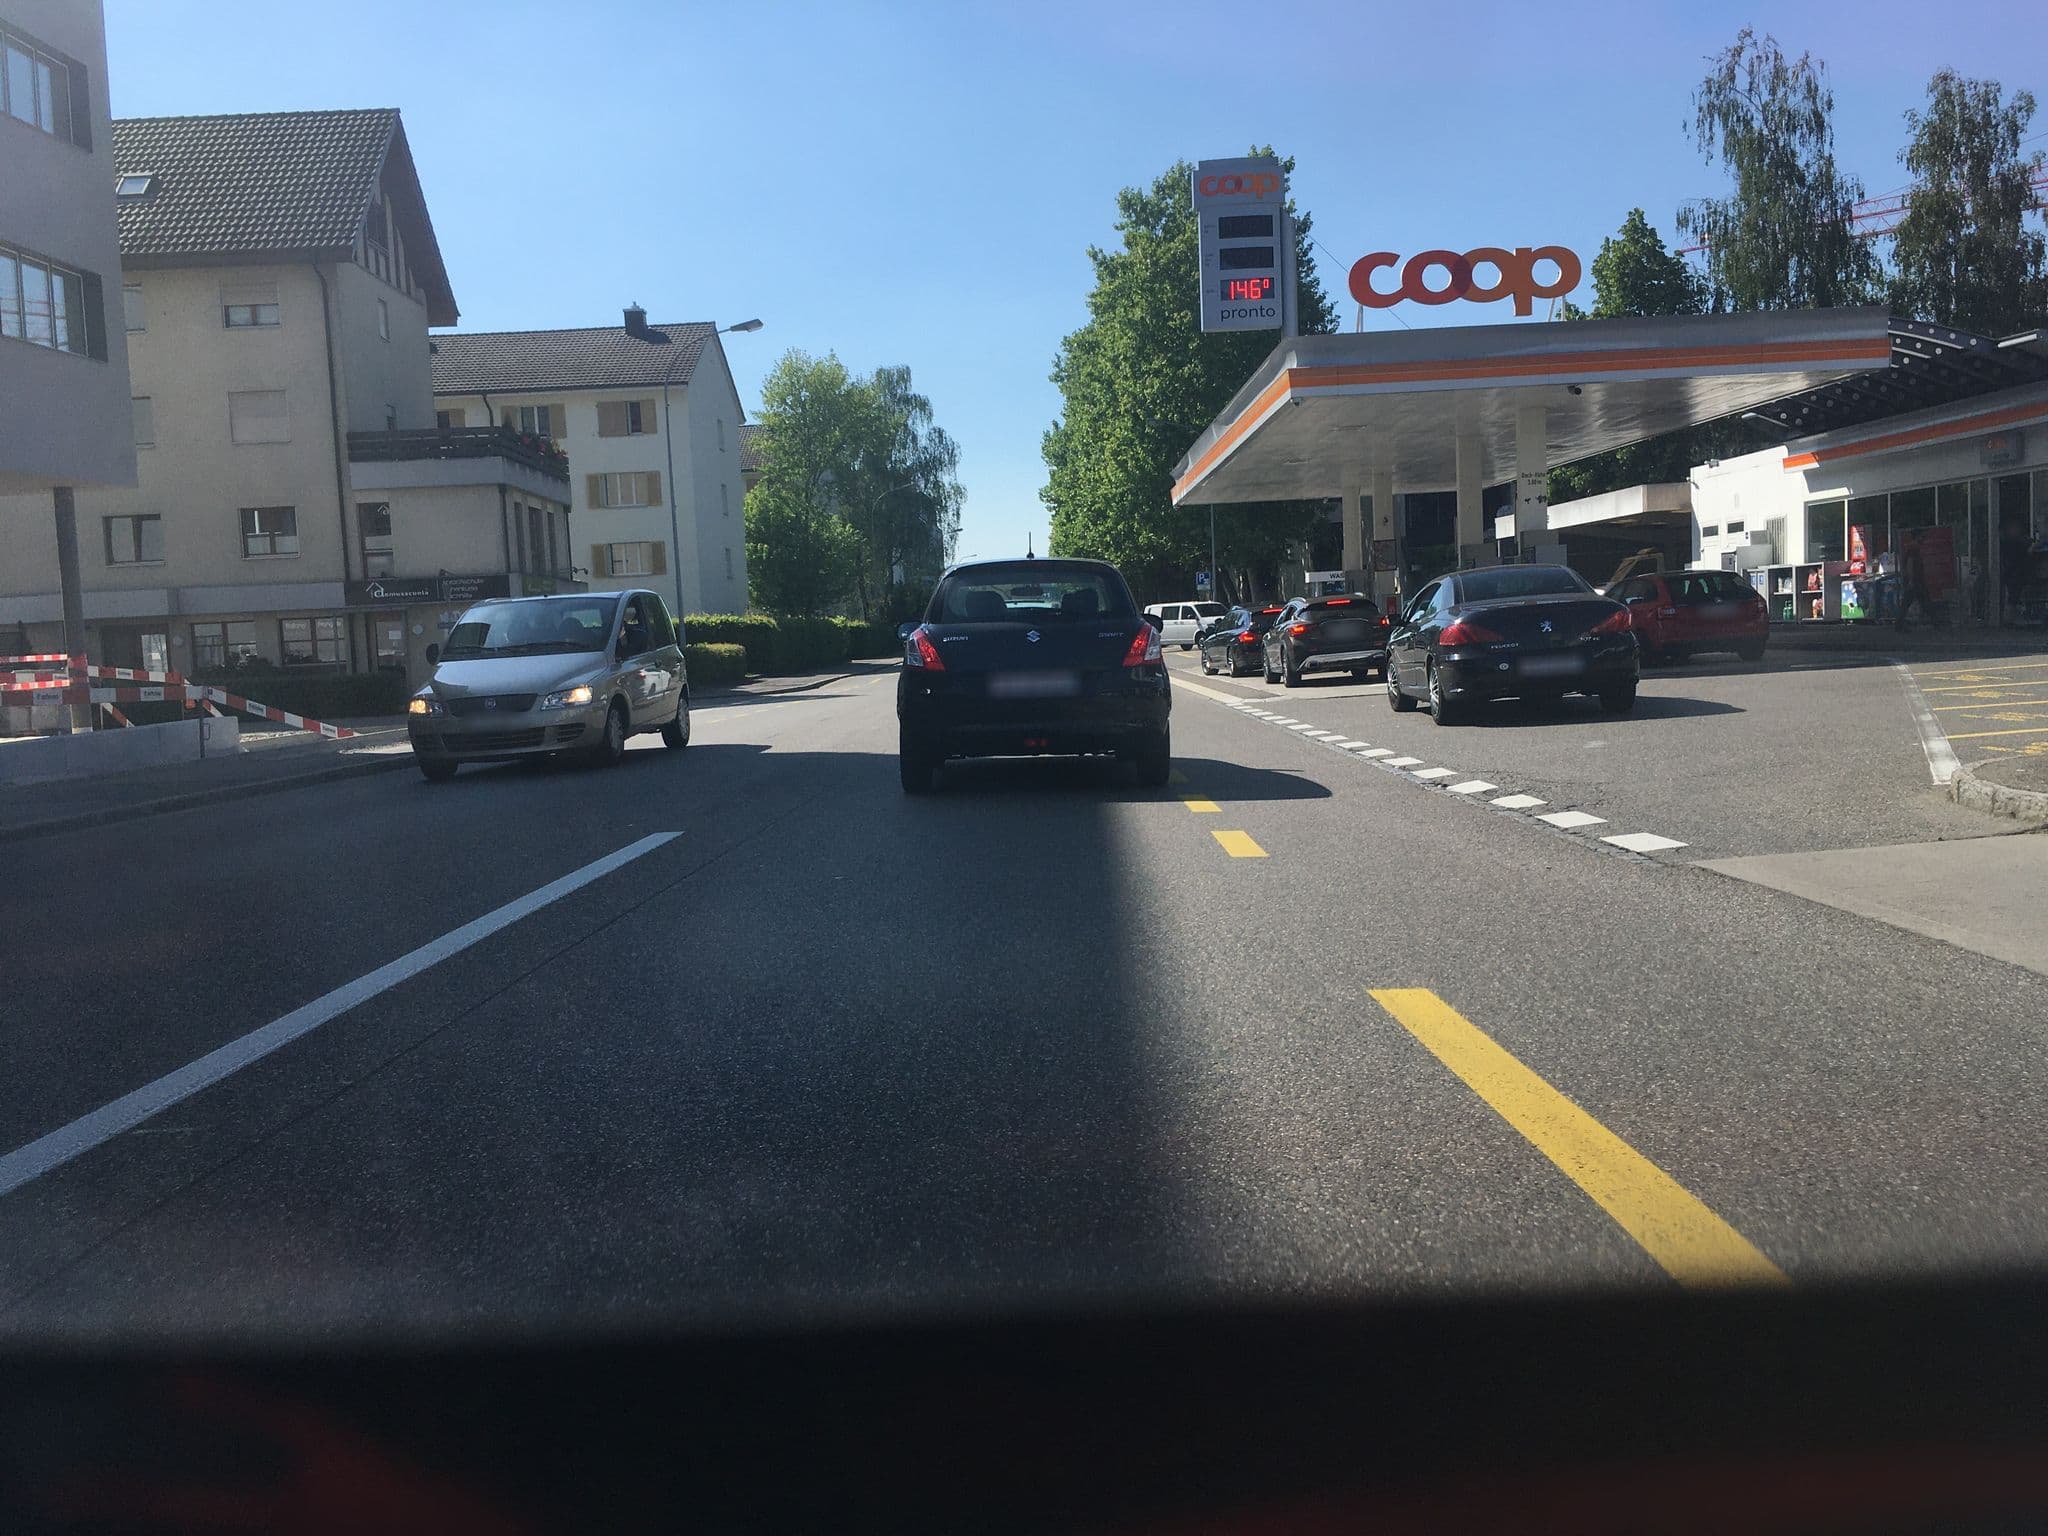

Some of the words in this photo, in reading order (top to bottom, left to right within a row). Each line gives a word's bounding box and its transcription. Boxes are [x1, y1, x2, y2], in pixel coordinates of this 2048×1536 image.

[1200, 172, 1280, 199] coop
[1348, 245, 1582, 317] coop
[1220, 305, 1276, 322] pronto
